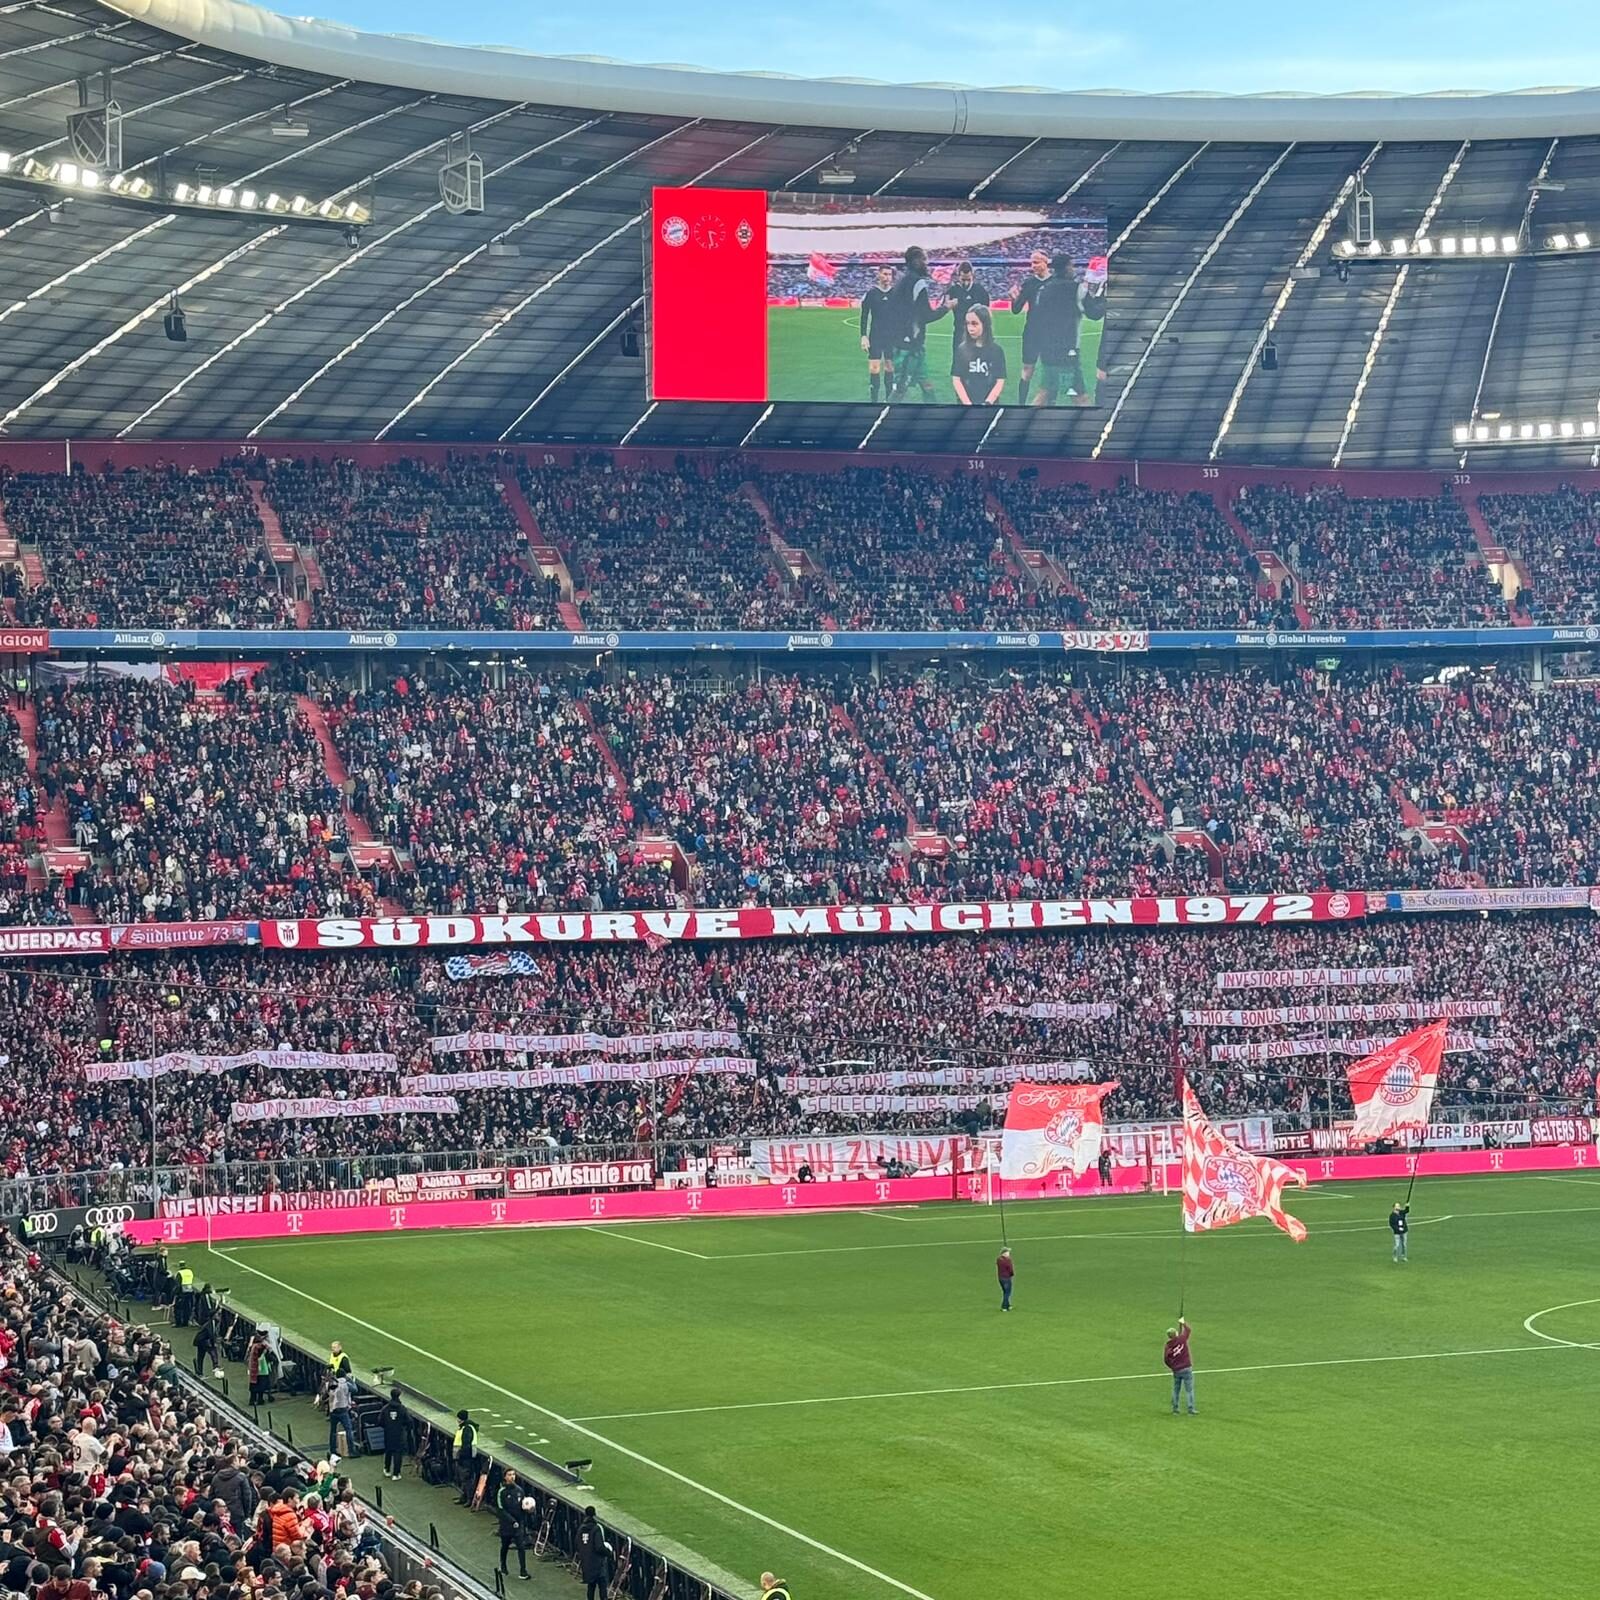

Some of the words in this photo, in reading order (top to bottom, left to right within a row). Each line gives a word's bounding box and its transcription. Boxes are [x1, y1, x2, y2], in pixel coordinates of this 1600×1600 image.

[968, 357, 989, 377] sky
[967, 459, 985, 471] 314
[1202, 467, 1220, 479] 313
[1452, 474, 1471, 486] 312
[113, 633, 150, 644] Allianz
[349, 634, 383, 645] Allianz
[572, 635, 605, 645] Allianz
[788, 635, 819, 645] Allianz
[996, 635, 1027, 645] Allianz
[1063, 631, 1115, 649] SUPS
[1119, 631, 1147, 649] 94
[1235, 634, 1265, 644] Allianz
[1278, 635, 1305, 644] Global
[1307, 634, 1346, 644] Investors
[1553, 629, 1585, 639] Allianz
[316, 911, 740, 947] SÜDKURVE
[772, 900, 1136, 935] MÜNCHEN
[1157, 895, 1313, 923] 1972
[129, 927, 205, 945] Südkurve
[1341, 970, 1359, 981] MIT
[1365, 969, 1389, 983] CVC
[1188, 1012, 1197, 1024] 3
[1200, 1011, 1223, 1024] MIO
[1225, 1011, 1234, 1025] €
[1241, 1009, 1282, 1025] BONUS
[1314, 1006, 1337, 1020] DEN
[1342, 1004, 1400, 1020] LIGA-BOSS
[1406, 1003, 1418, 1016] IN
[1422, 1001, 1496, 1017] FRANKREICH
[433, 1035, 464, 1051] CVC
[1216, 1044, 1262, 1059] WELCHE
[1267, 1041, 1295, 1056] BONI
[517, 1067, 585, 1087] KAPITAL
[591, 1066, 605, 1081] IN
[610, 1064, 642, 1080] DER
[785, 1072, 894, 1094] BLACKSTONE
[906, 1071, 936, 1085] GUT
[235, 1103, 258, 1117] CVC
[263, 1101, 287, 1116] UND
[807, 1096, 895, 1114] SCHLECHT
[1533, 1119, 1575, 1143] SELTERS
[513, 1164, 621, 1190] alarMstufe
[623, 1162, 652, 1184] rot
